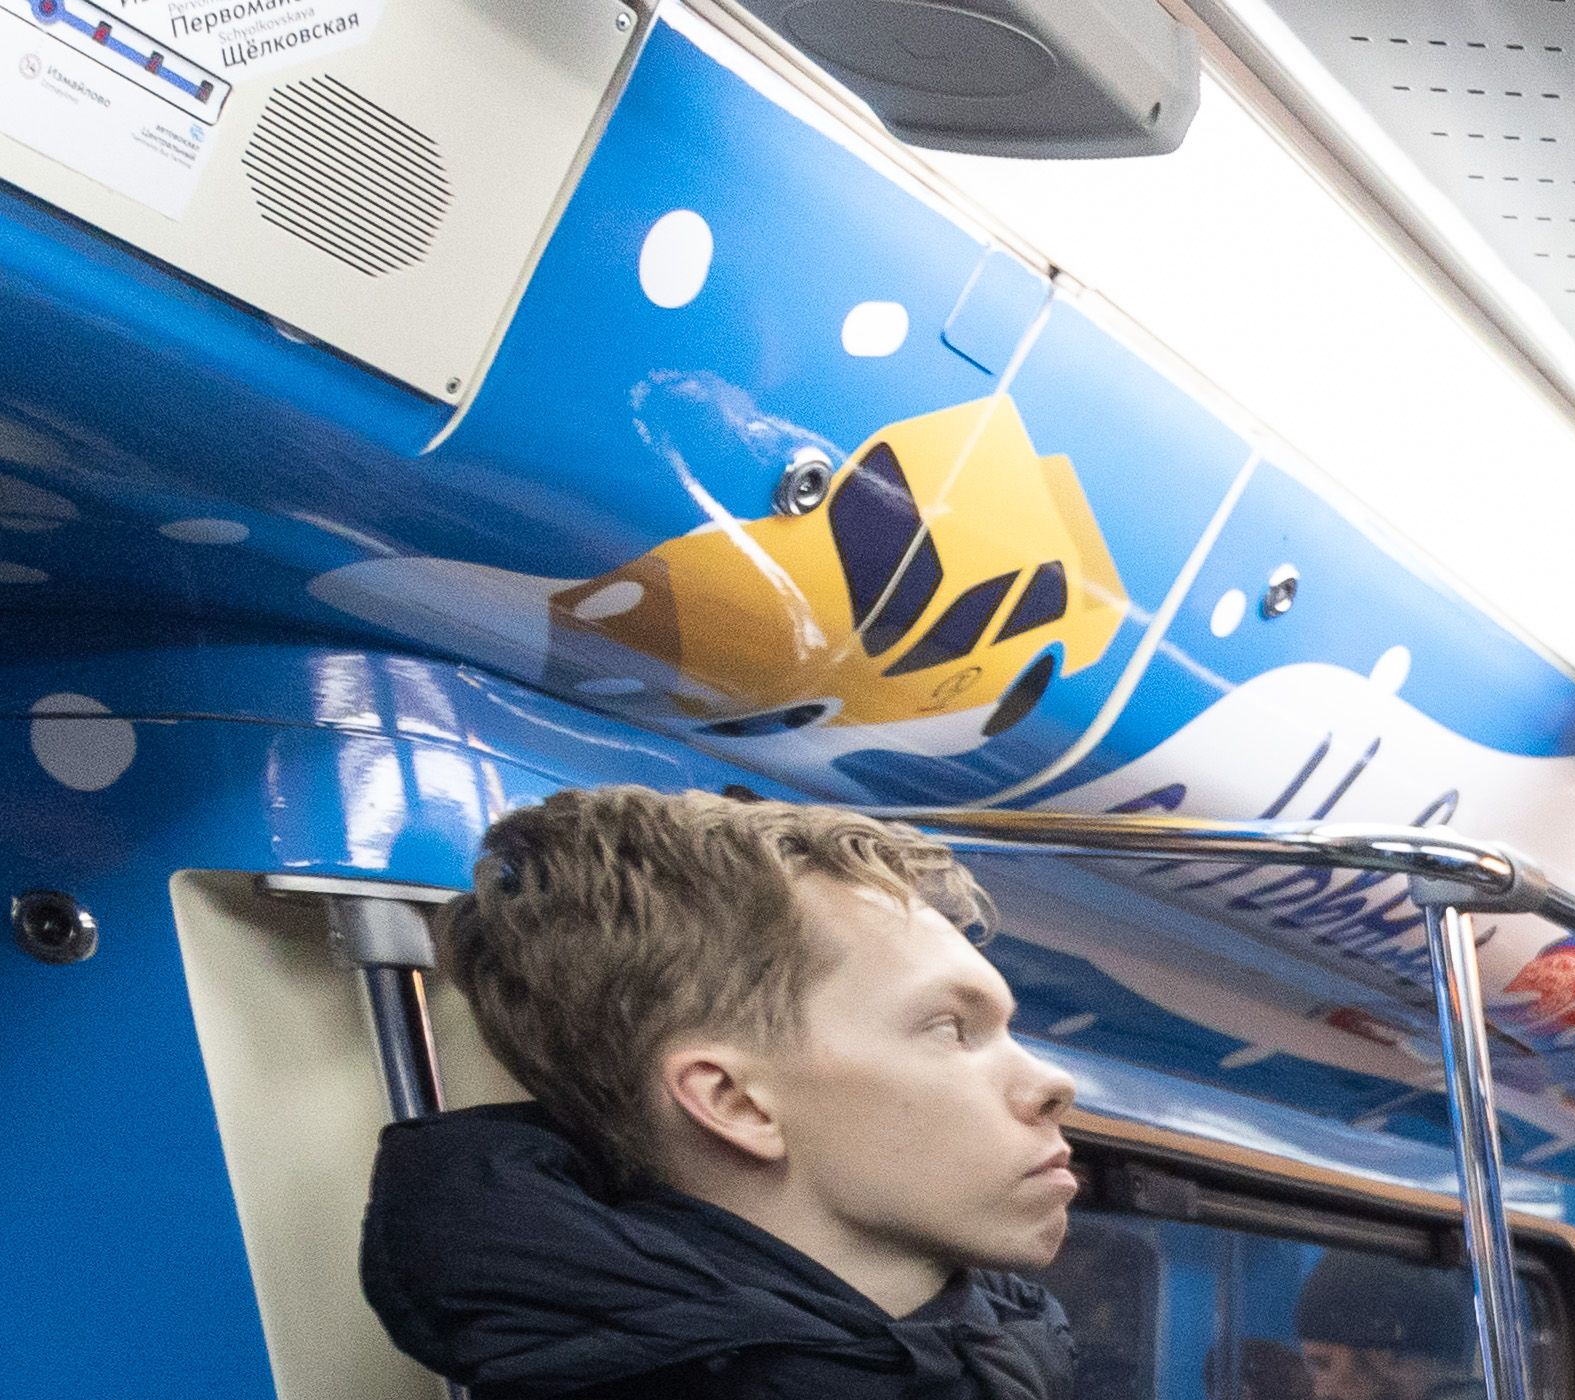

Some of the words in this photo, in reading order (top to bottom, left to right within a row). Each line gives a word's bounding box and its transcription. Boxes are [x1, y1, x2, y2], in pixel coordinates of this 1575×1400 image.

[170, 0, 300, 38] Первомай
[221, 12, 360, 68] Щёлковская
[47, 65, 111, 108] Измайлово
